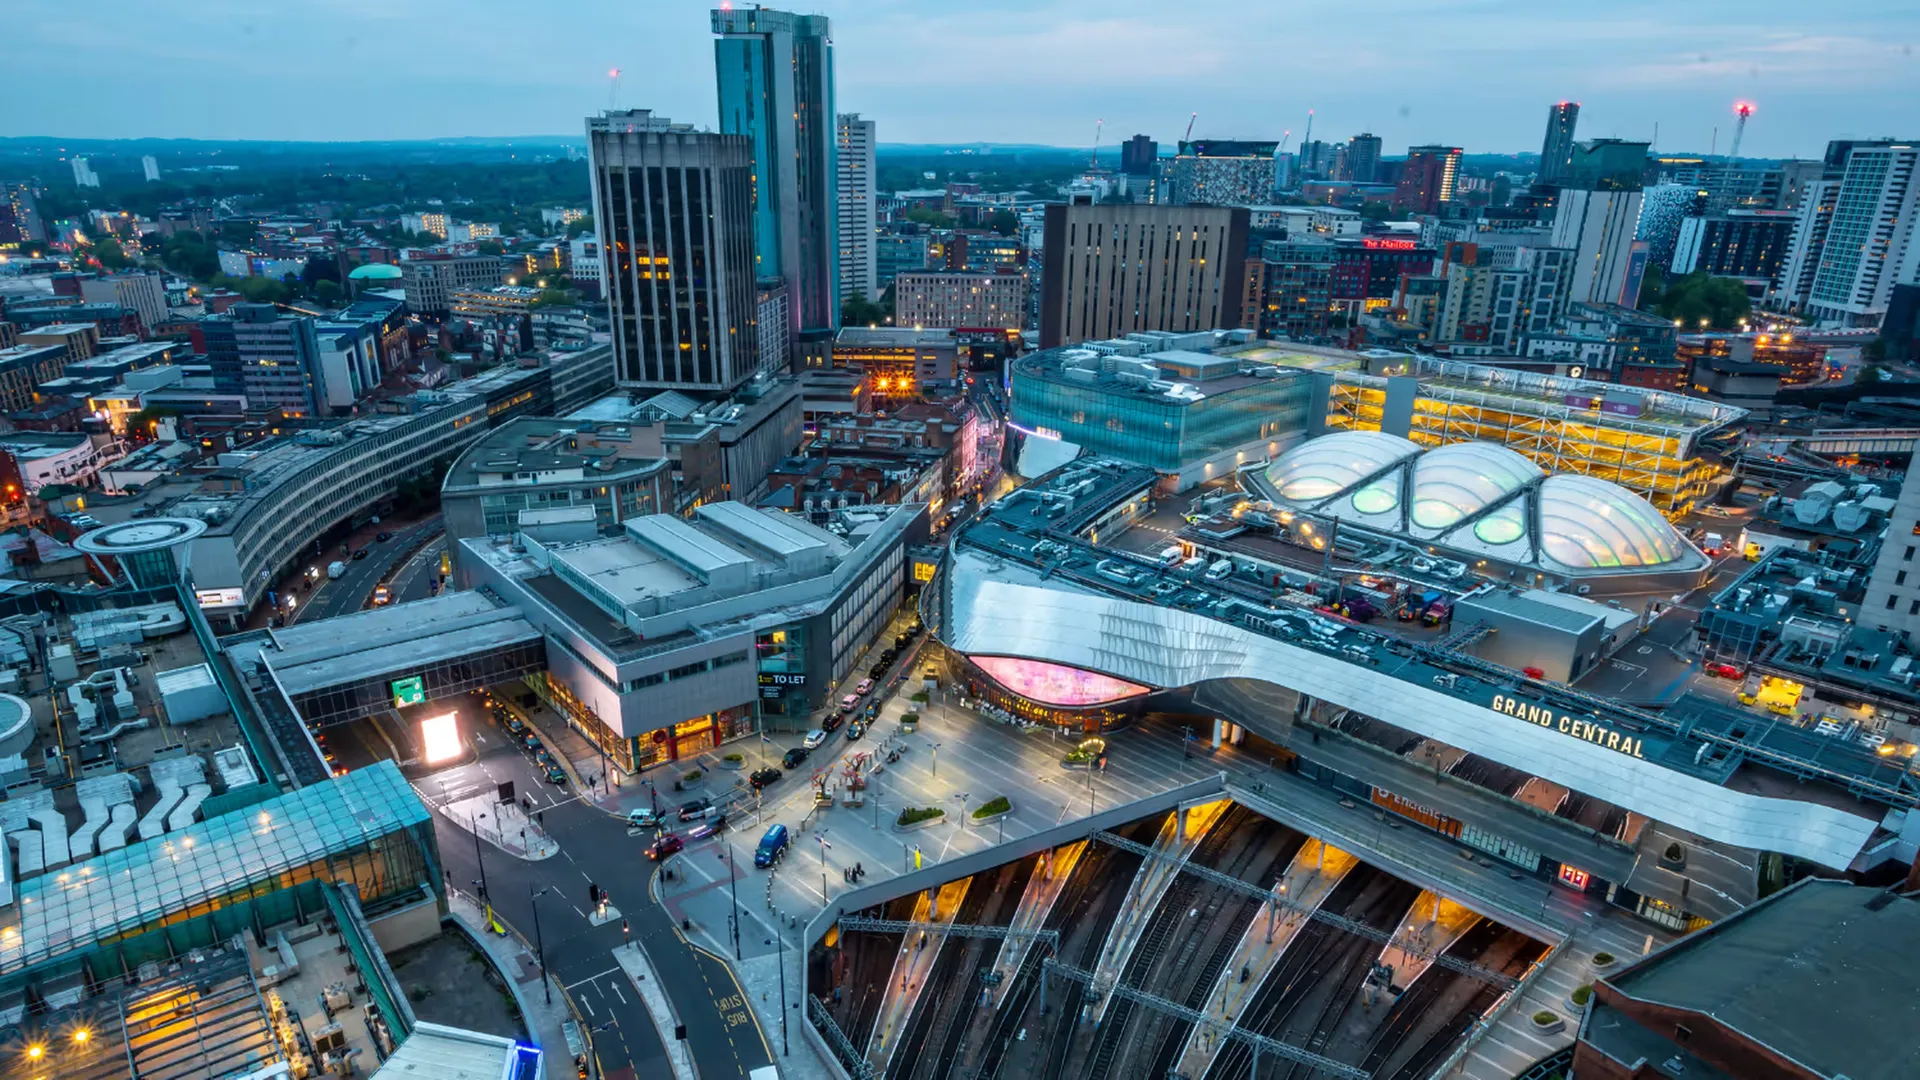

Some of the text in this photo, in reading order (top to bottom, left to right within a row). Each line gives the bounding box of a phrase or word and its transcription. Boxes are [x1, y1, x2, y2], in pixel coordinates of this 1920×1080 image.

[1380, 239, 1415, 250] Mailbox
[773, 674, 787, 684] TO
[788, 675, 806, 684] LET
[1492, 694, 1643, 758] GRAND CENTRAL
[719, 994, 743, 1012] STOP
[727, 1011, 748, 1027] BUS
